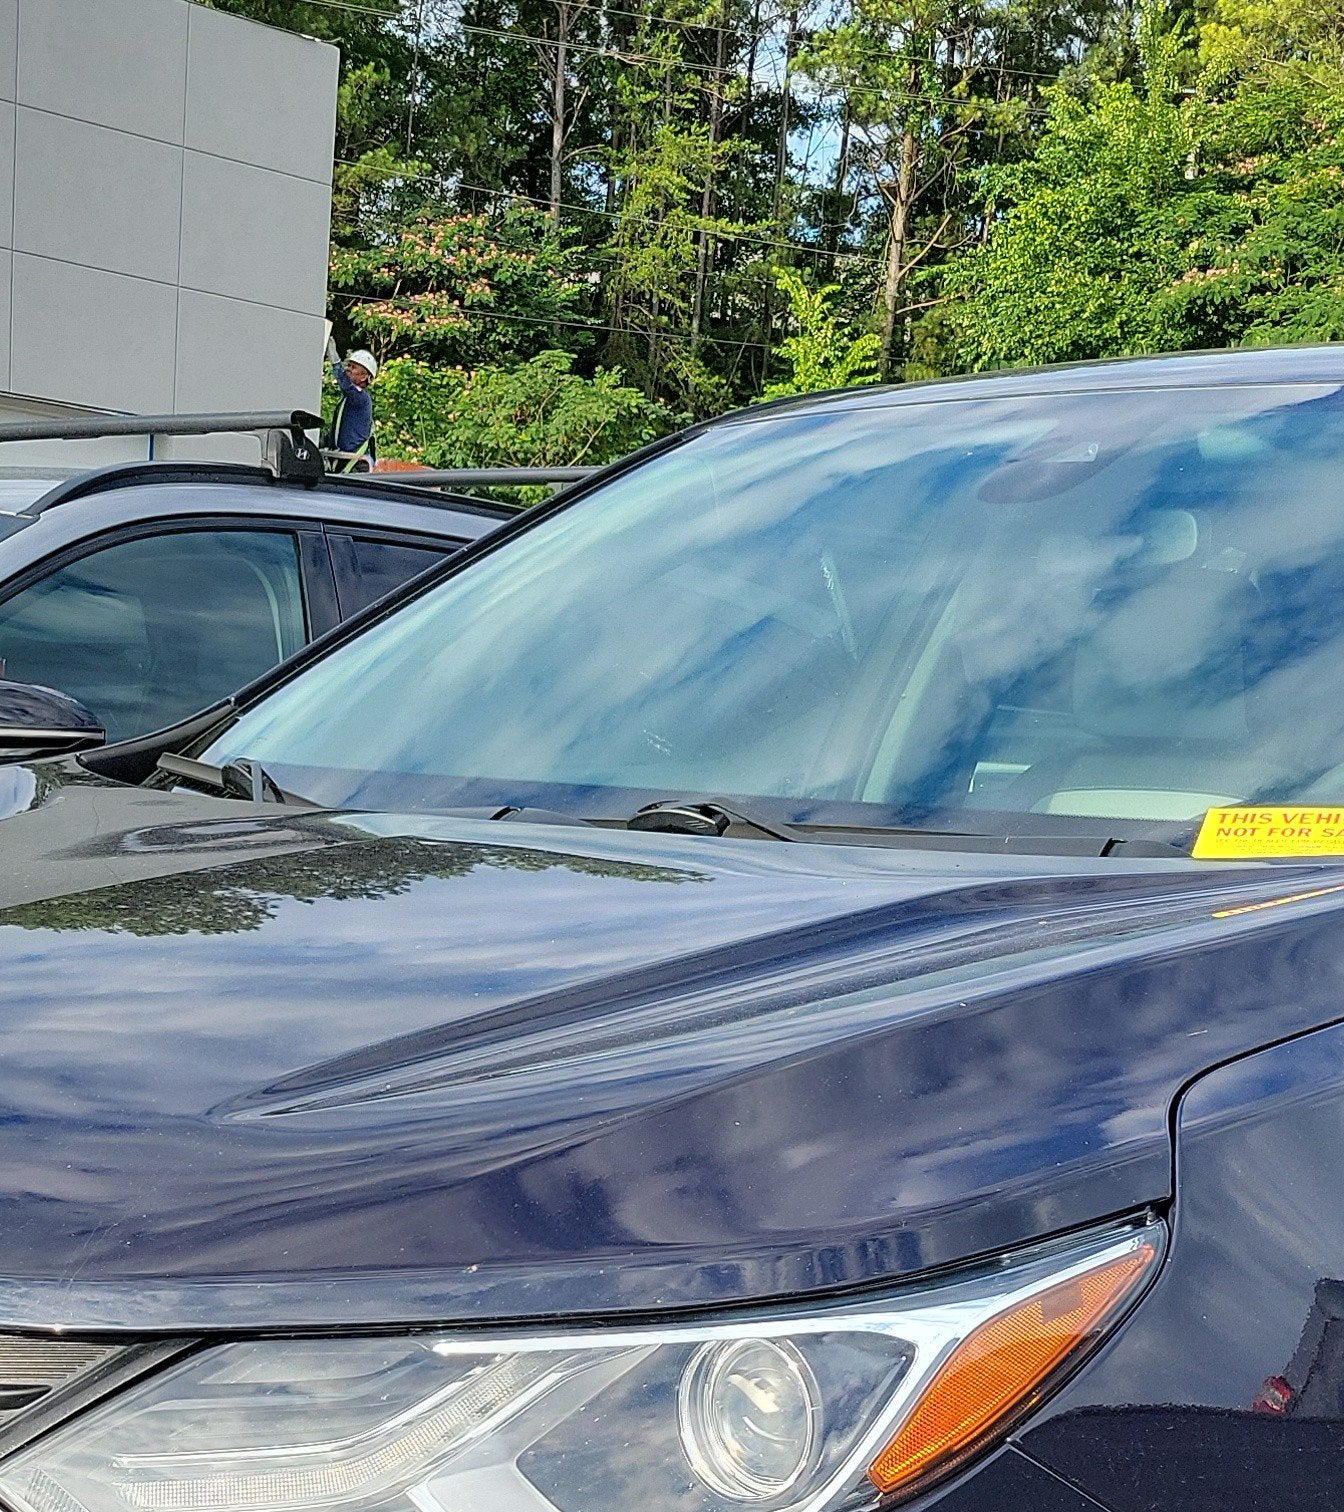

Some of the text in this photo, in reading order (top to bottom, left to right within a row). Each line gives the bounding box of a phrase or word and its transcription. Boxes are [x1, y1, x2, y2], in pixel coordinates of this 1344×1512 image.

[1218, 813, 1273, 825] THIS
[1216, 827, 1261, 837] NOT
[1267, 827, 1312, 838] FOR
